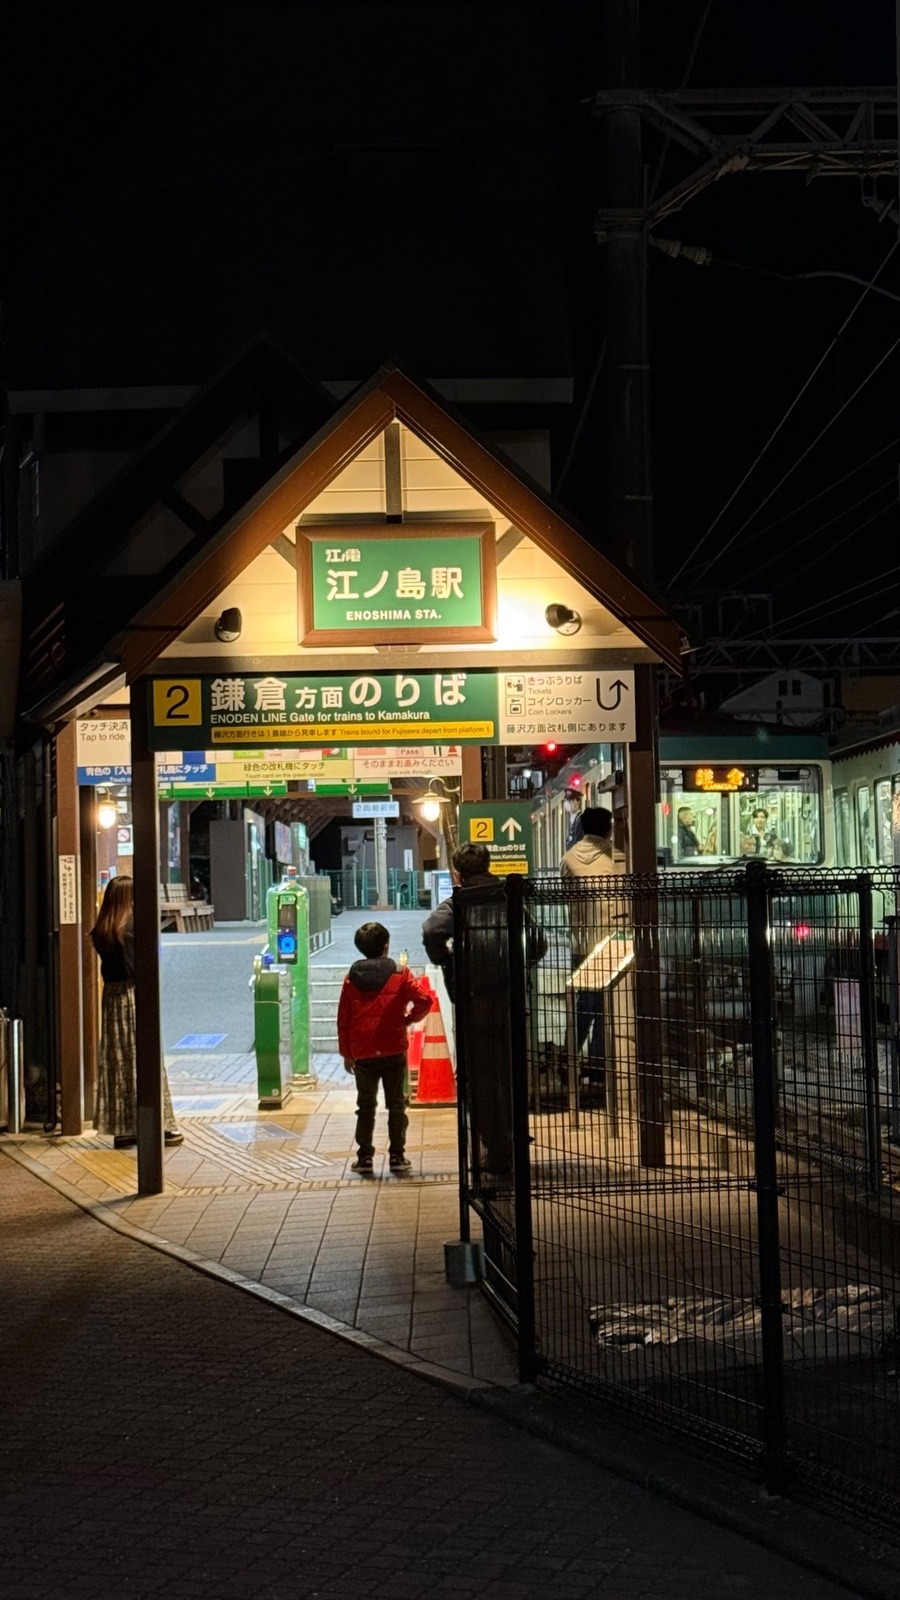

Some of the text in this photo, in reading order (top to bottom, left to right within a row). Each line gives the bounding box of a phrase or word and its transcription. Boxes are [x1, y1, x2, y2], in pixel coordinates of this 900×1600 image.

[326, 567, 464, 600] 江ノ島駅
[346, 609, 442, 621] ENOSHIMA STA.
[166, 685, 190, 719] 2
[528, 697, 592, 706] コインロッカー
[211, 710, 430, 724] ENODEN LINE Gate for trains to Kamakura
[528, 708, 572, 716] Coin Lockers
[80, 721, 128, 731] タッチ決済
[507, 722, 628, 734] 藤沢方面改札側にあります
[392, 728, 420, 736] Fujisawa
[459, 727, 484, 735] platform
[81, 732, 125, 742] Tap to ride
[244, 762, 326, 771] 緑色の改札機にタッチ
[363, 759, 454, 768] そのままお進みください
[476, 822, 488, 838] 2
